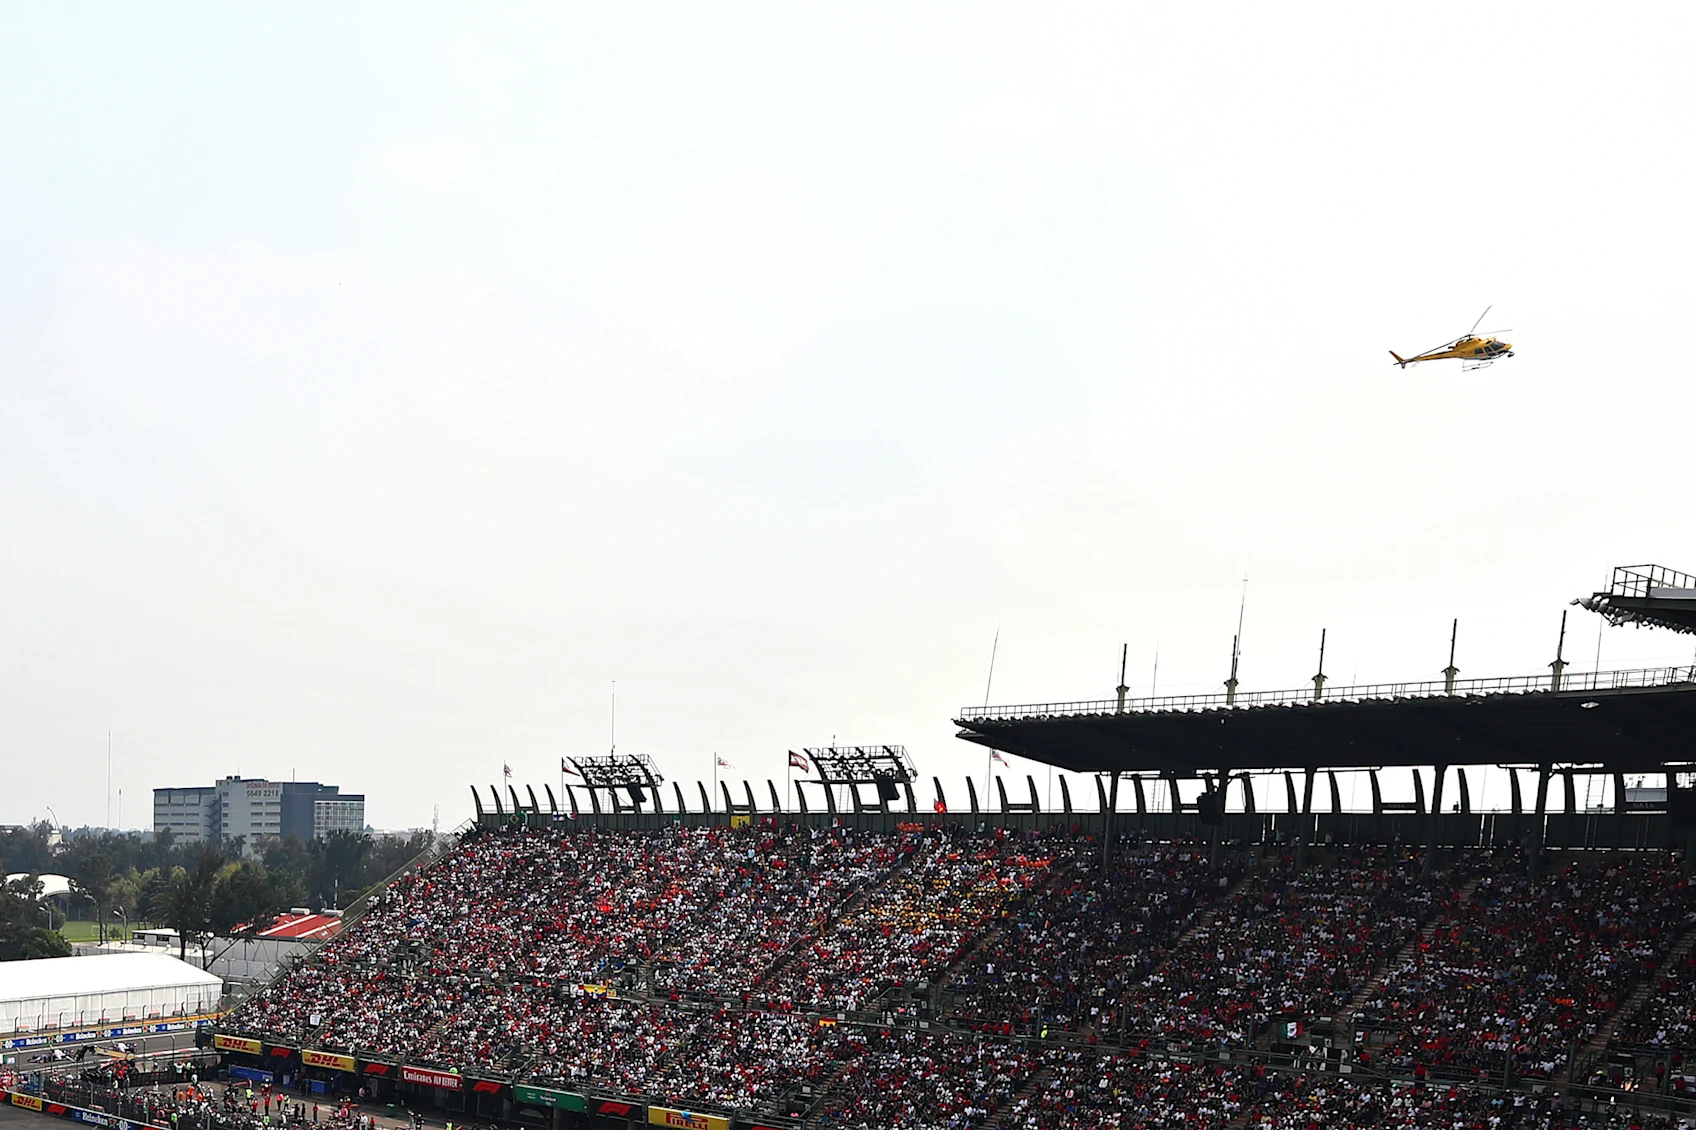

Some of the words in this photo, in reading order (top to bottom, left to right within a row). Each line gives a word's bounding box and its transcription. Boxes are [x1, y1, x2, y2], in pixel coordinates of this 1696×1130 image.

[223, 1038, 248, 1050] DHL
[311, 1054, 340, 1067] DHL
[404, 1070, 432, 1084] Emirates
[17, 1096, 38, 1107] DHL
[82, 1112, 108, 1126] Heineken
[666, 1112, 708, 1130] PIRELLI
